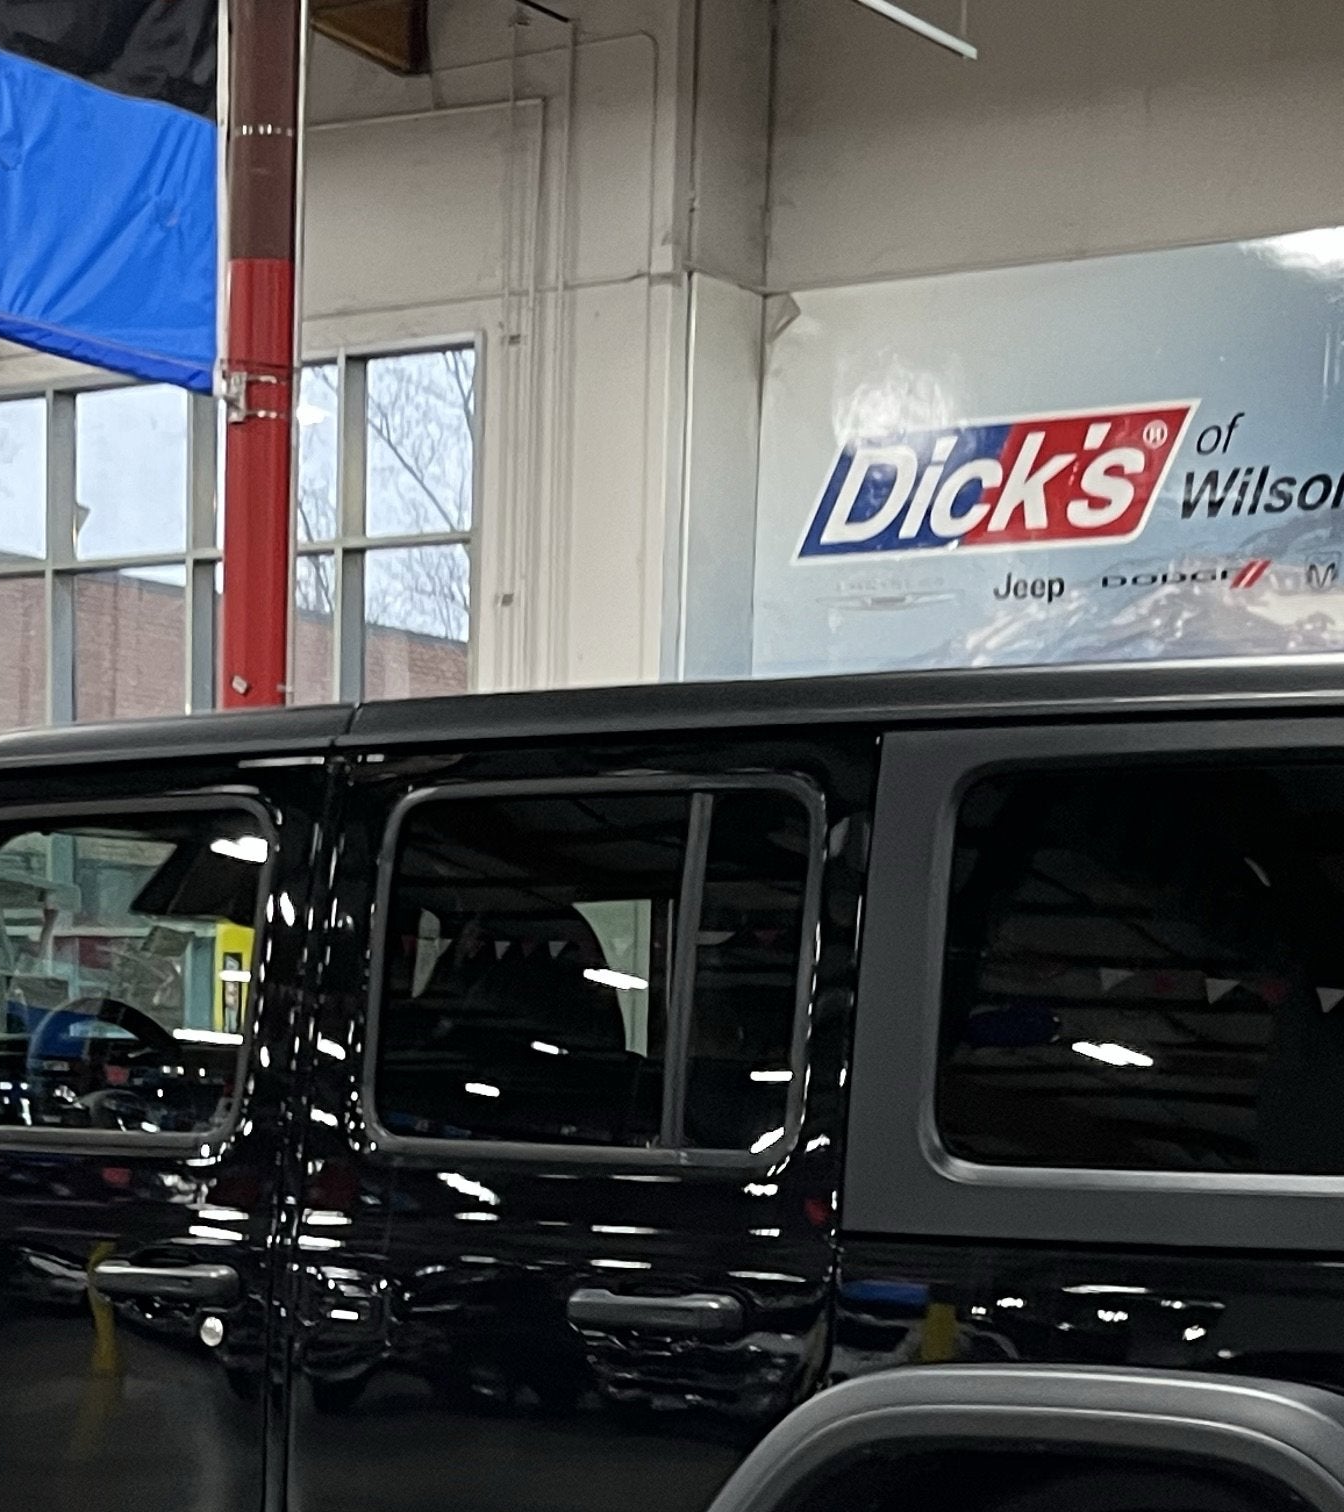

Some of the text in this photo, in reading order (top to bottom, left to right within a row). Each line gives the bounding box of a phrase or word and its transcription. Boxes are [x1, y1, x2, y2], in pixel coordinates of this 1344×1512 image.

[820, 412, 1245, 545] Dick's of
[993, 572, 1065, 603] Jeep
